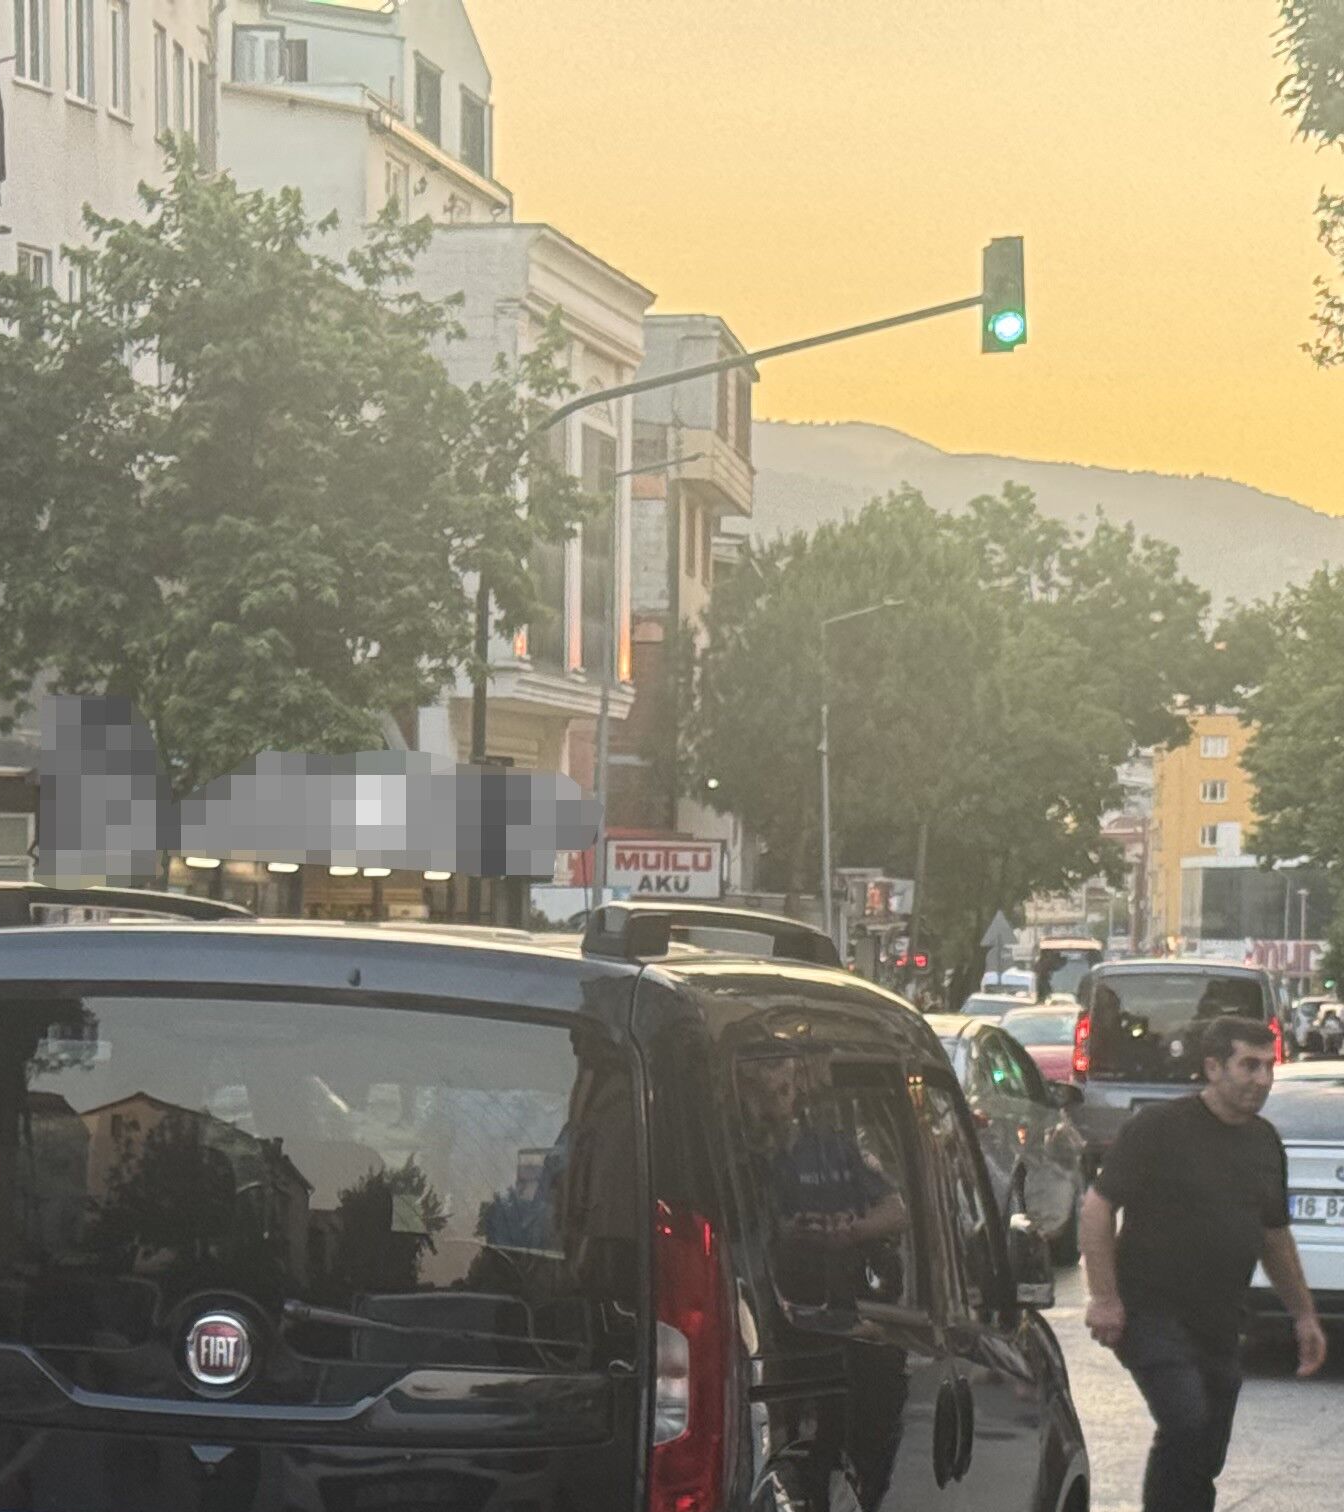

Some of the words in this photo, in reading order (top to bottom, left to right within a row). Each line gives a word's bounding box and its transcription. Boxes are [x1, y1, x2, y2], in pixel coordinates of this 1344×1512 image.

[614, 845, 712, 872] MUTLU
[1297, 1198, 1316, 1217] 16
[200, 1335, 239, 1367] FIAT
